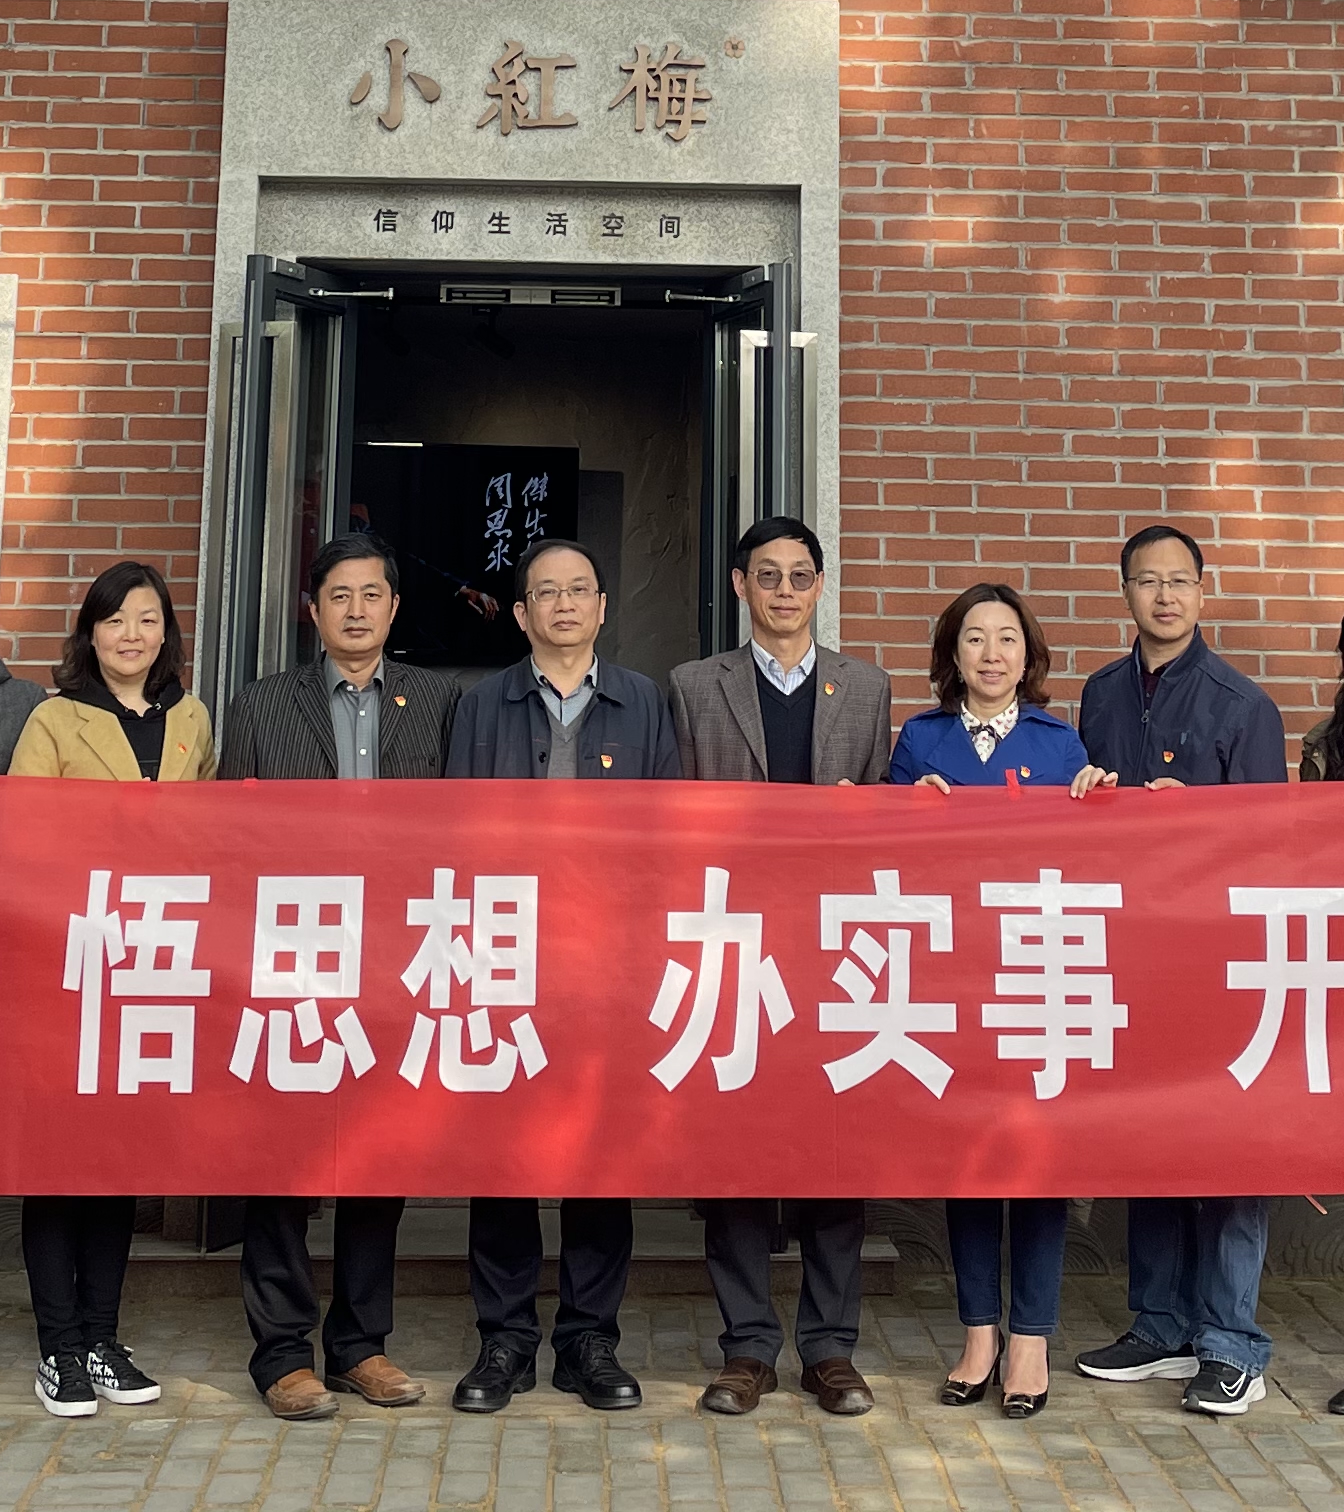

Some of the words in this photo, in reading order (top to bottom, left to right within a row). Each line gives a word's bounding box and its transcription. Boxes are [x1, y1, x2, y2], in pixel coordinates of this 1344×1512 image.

[350, 37, 714, 142] 小紅梅
[373, 207, 683, 239] 信仰生活空间
[519, 471, 549, 557] 傑出
[62, 867, 548, 1095] 悟思想
[648, 866, 1129, 1100] 办实事
